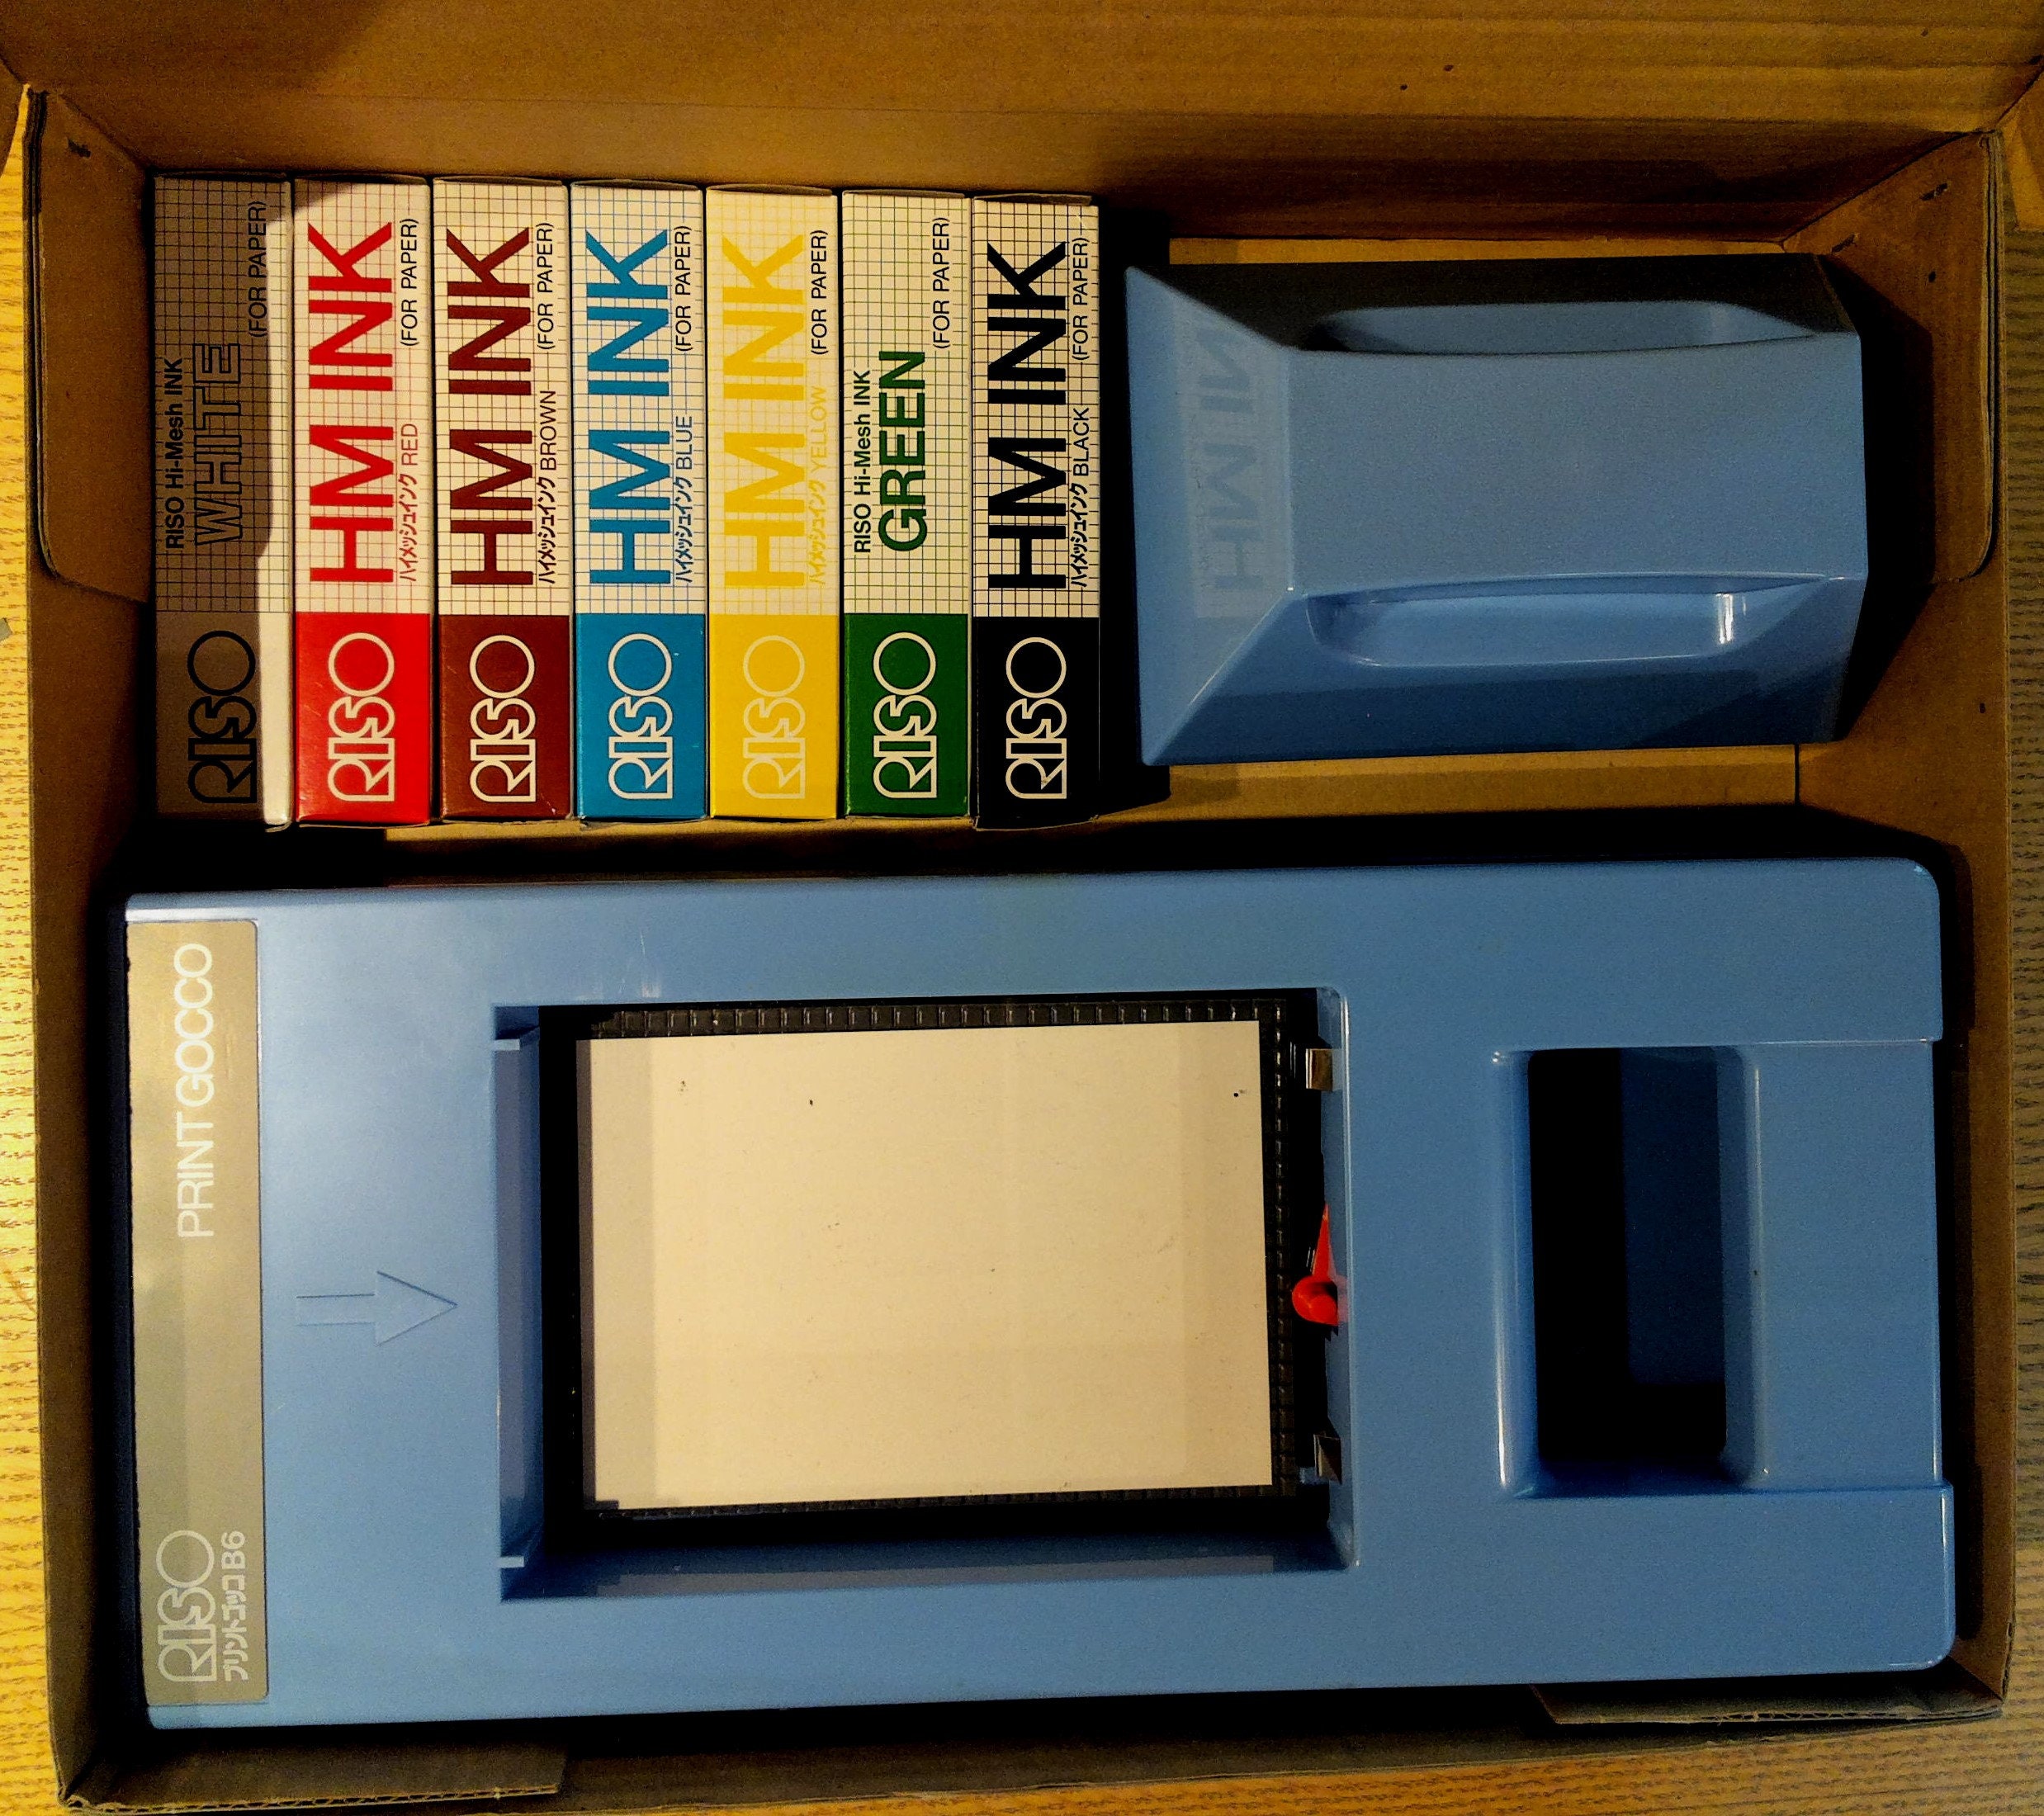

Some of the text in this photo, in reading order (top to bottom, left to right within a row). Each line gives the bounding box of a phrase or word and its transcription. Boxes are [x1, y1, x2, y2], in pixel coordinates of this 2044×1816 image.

[245, 200, 269, 338] (FOR PAPER)
[399, 217, 421, 348] (FOR PAPER)
[534, 222, 558, 351] (FOR PAPER)
[673, 225, 695, 353] (FOR PAPER)
[808, 229, 831, 357] (FOR PAPER)
[930, 216, 953, 351] (FOR PAPER)
[1070, 236, 1092, 362] (FOR PAPER)
[163, 357, 186, 550] RISO Hi-Mesh INK
[192, 342, 244, 546] WHITE
[307, 221, 395, 584] HM INK
[446, 227, 534, 586] HM INK
[536, 389, 558, 584] ハイメッシュインク BROWN
[584, 229, 672, 584] HM INK
[721, 234, 806, 588] HM INK
[806, 385, 828, 586] ハイメッシュインク YELLOW
[851, 370, 873, 554] RISO Hi-Mesh INK
[877, 351, 928, 552] GREEN
[985, 241, 1067, 590] HM INK
[398, 423, 420, 583] ハイメッシュインク RED
[673, 415, 695, 584] ハイメッシュインク BLUE
[1069, 406, 1091, 588] ハイメッシュインク BLACK
[187, 630, 258, 804] RISO
[328, 631, 395, 802] RISO
[469, 635, 537, 803] RISO
[607, 632, 674, 801] RISO
[742, 635, 807, 800] RISO
[872, 631, 939, 799] RISO
[1005, 636, 1068, 801] RISO
[155, 1530, 217, 1682] RISO
[220, 1530, 249, 1682] プリントゴッコ B6
